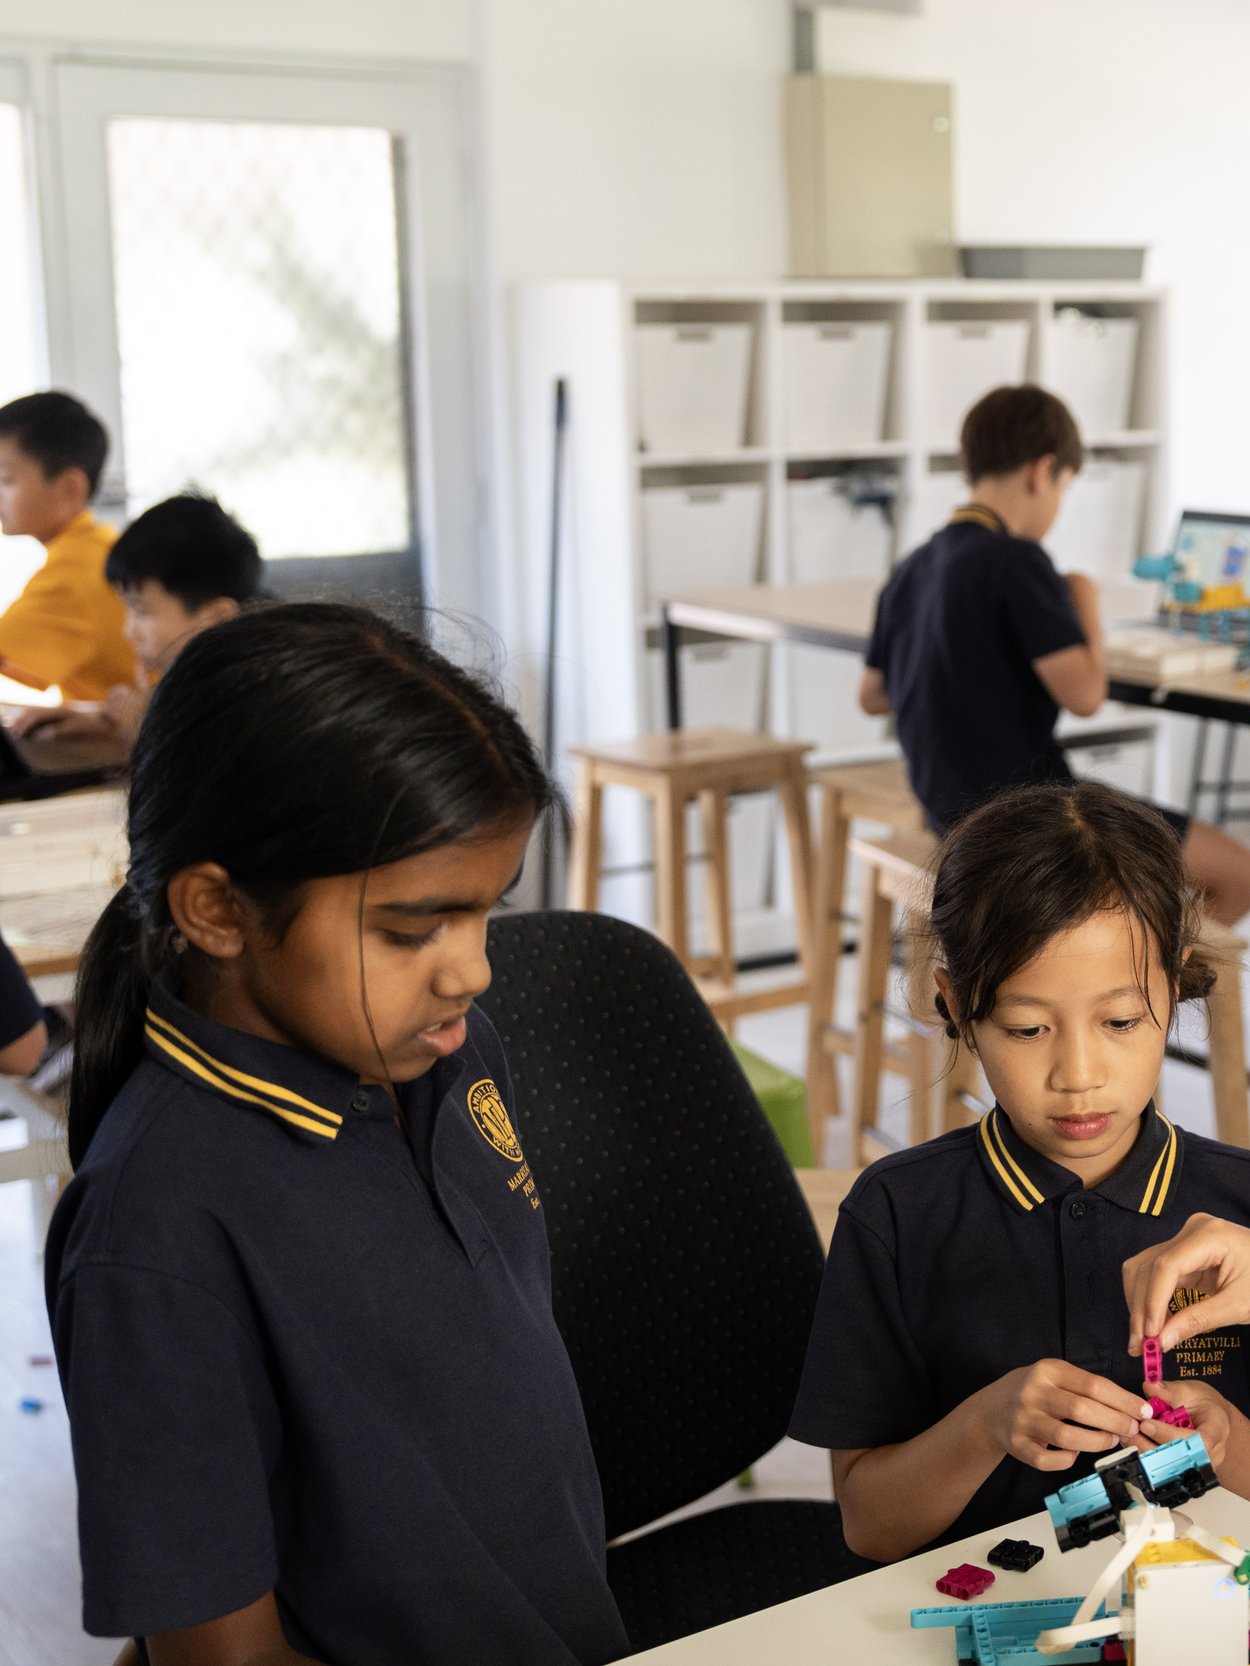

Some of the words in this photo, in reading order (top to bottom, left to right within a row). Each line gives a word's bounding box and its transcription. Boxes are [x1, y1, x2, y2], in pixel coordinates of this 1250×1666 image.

[473, 1085, 499, 1114] AMBITIO
[1176, 1350, 1225, 1363] PRIMARY
[1180, 1366, 1199, 1377] Est.
[1202, 1364, 1222, 1376] 1884
